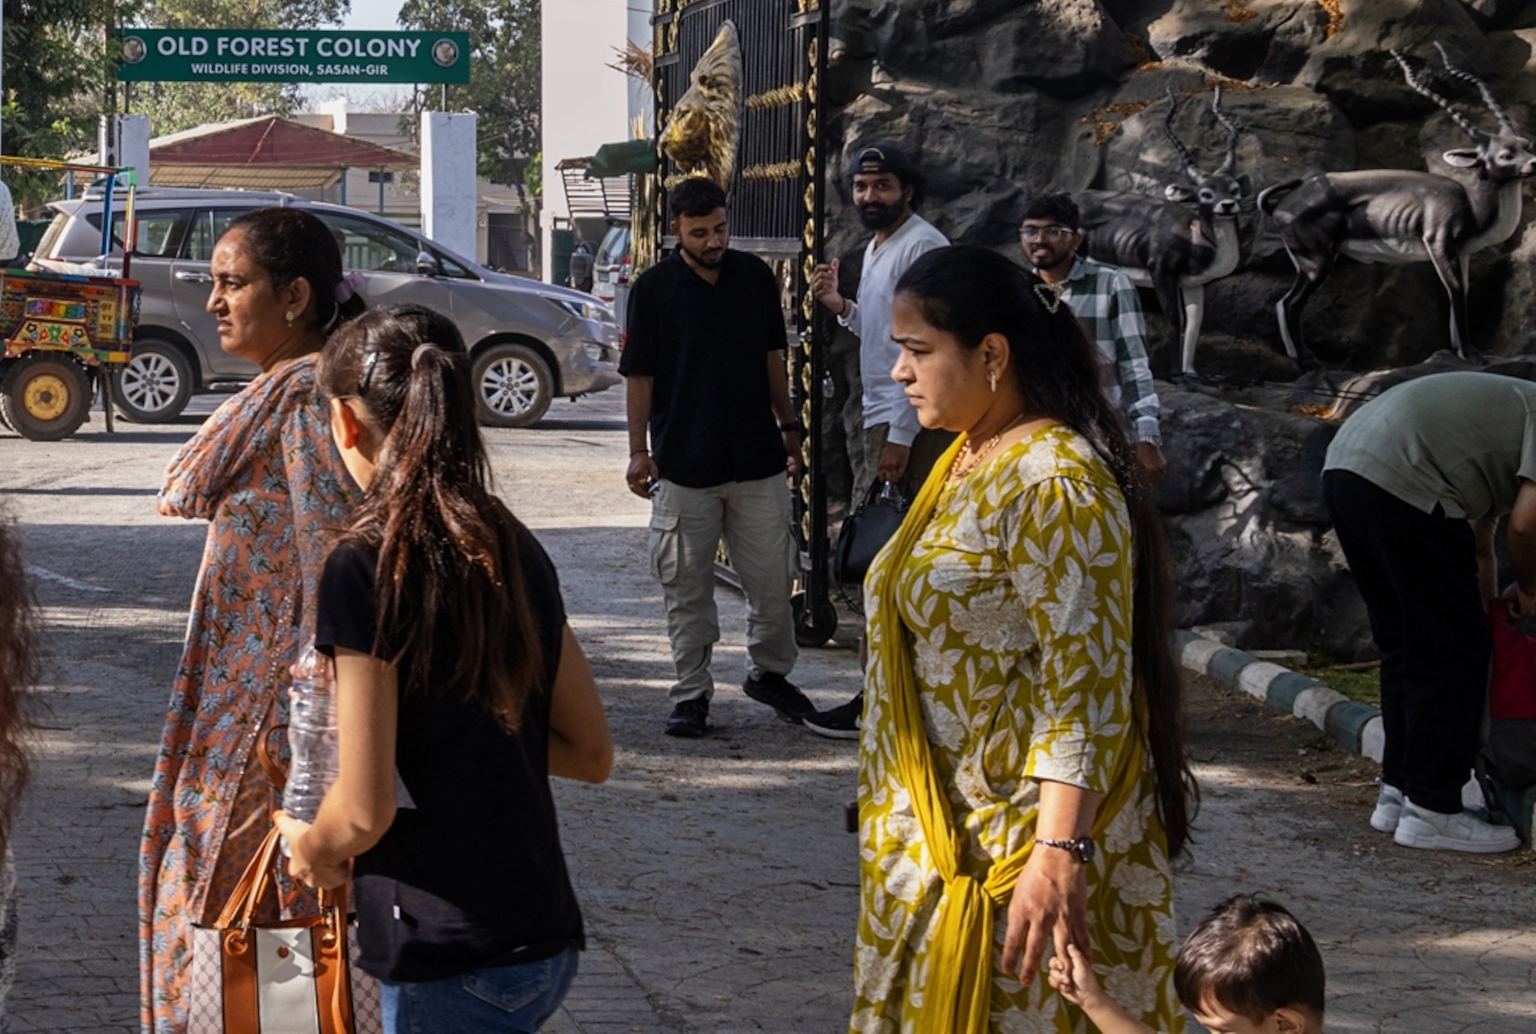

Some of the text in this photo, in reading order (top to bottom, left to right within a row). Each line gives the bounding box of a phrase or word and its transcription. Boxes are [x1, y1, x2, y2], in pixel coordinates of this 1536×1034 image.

[157, 36, 421, 58] OLD FOREST COLONY
[191, 63, 388, 76] WILDLIFE DIVISION, SASAN-GIR
